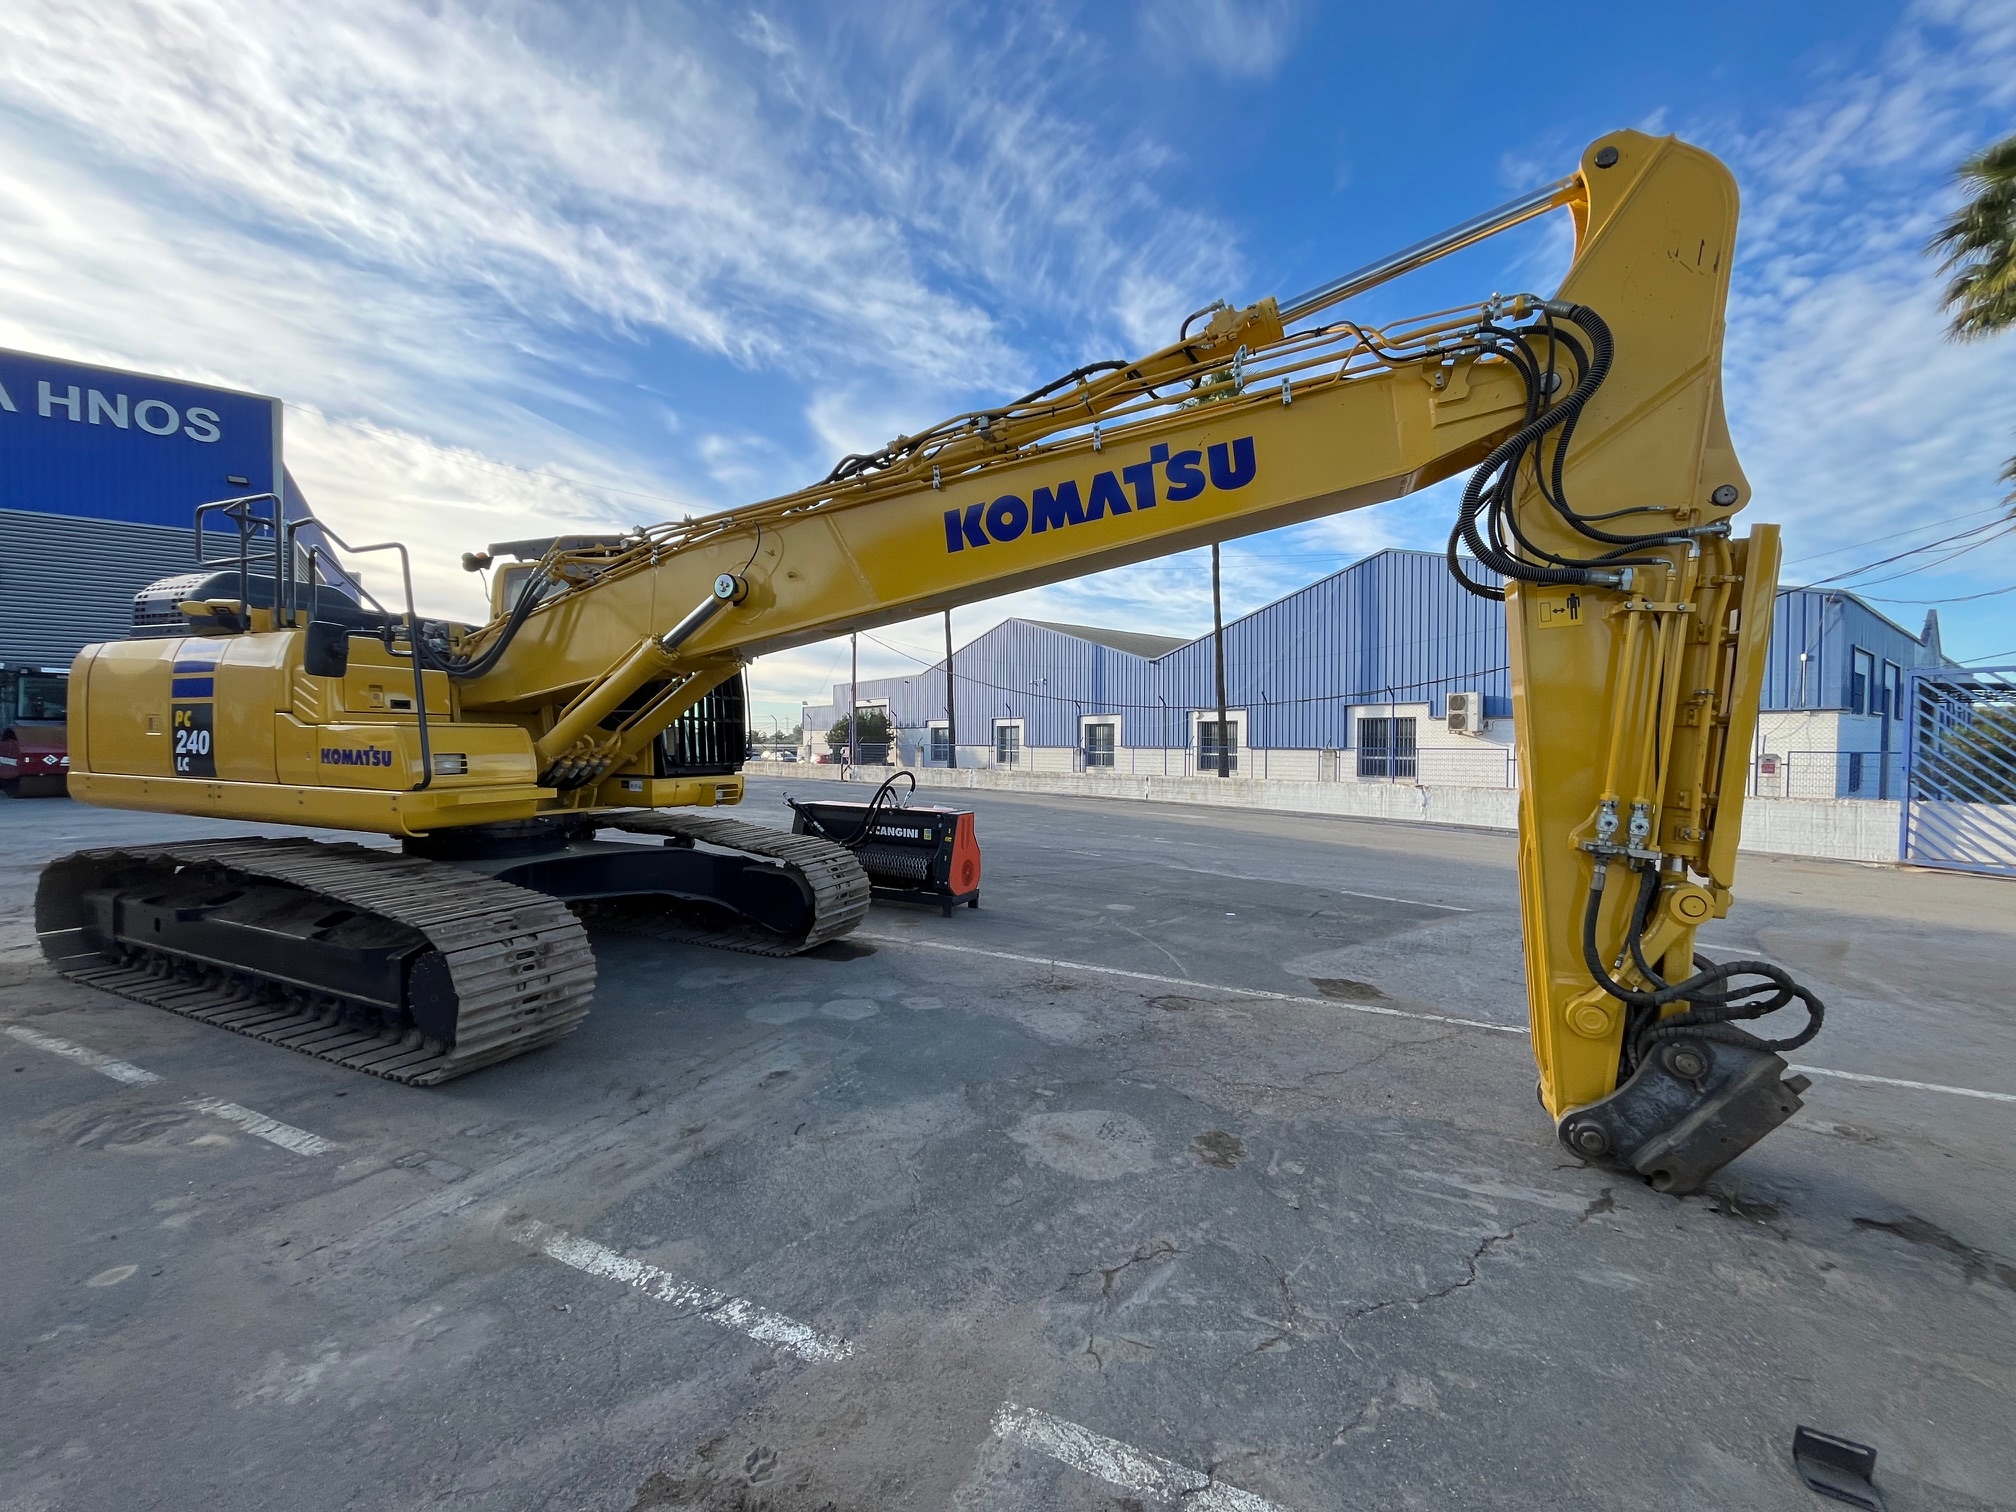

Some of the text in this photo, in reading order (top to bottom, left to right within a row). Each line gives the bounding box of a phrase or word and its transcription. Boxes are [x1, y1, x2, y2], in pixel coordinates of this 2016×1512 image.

[38, 380, 221, 443] HNOS
[944, 436, 1257, 553] KOMATSU
[175, 710, 192, 727] PC
[175, 730, 210, 755] 240
[177, 756, 190, 771] LC
[320, 745, 392, 767] KOMATSU
